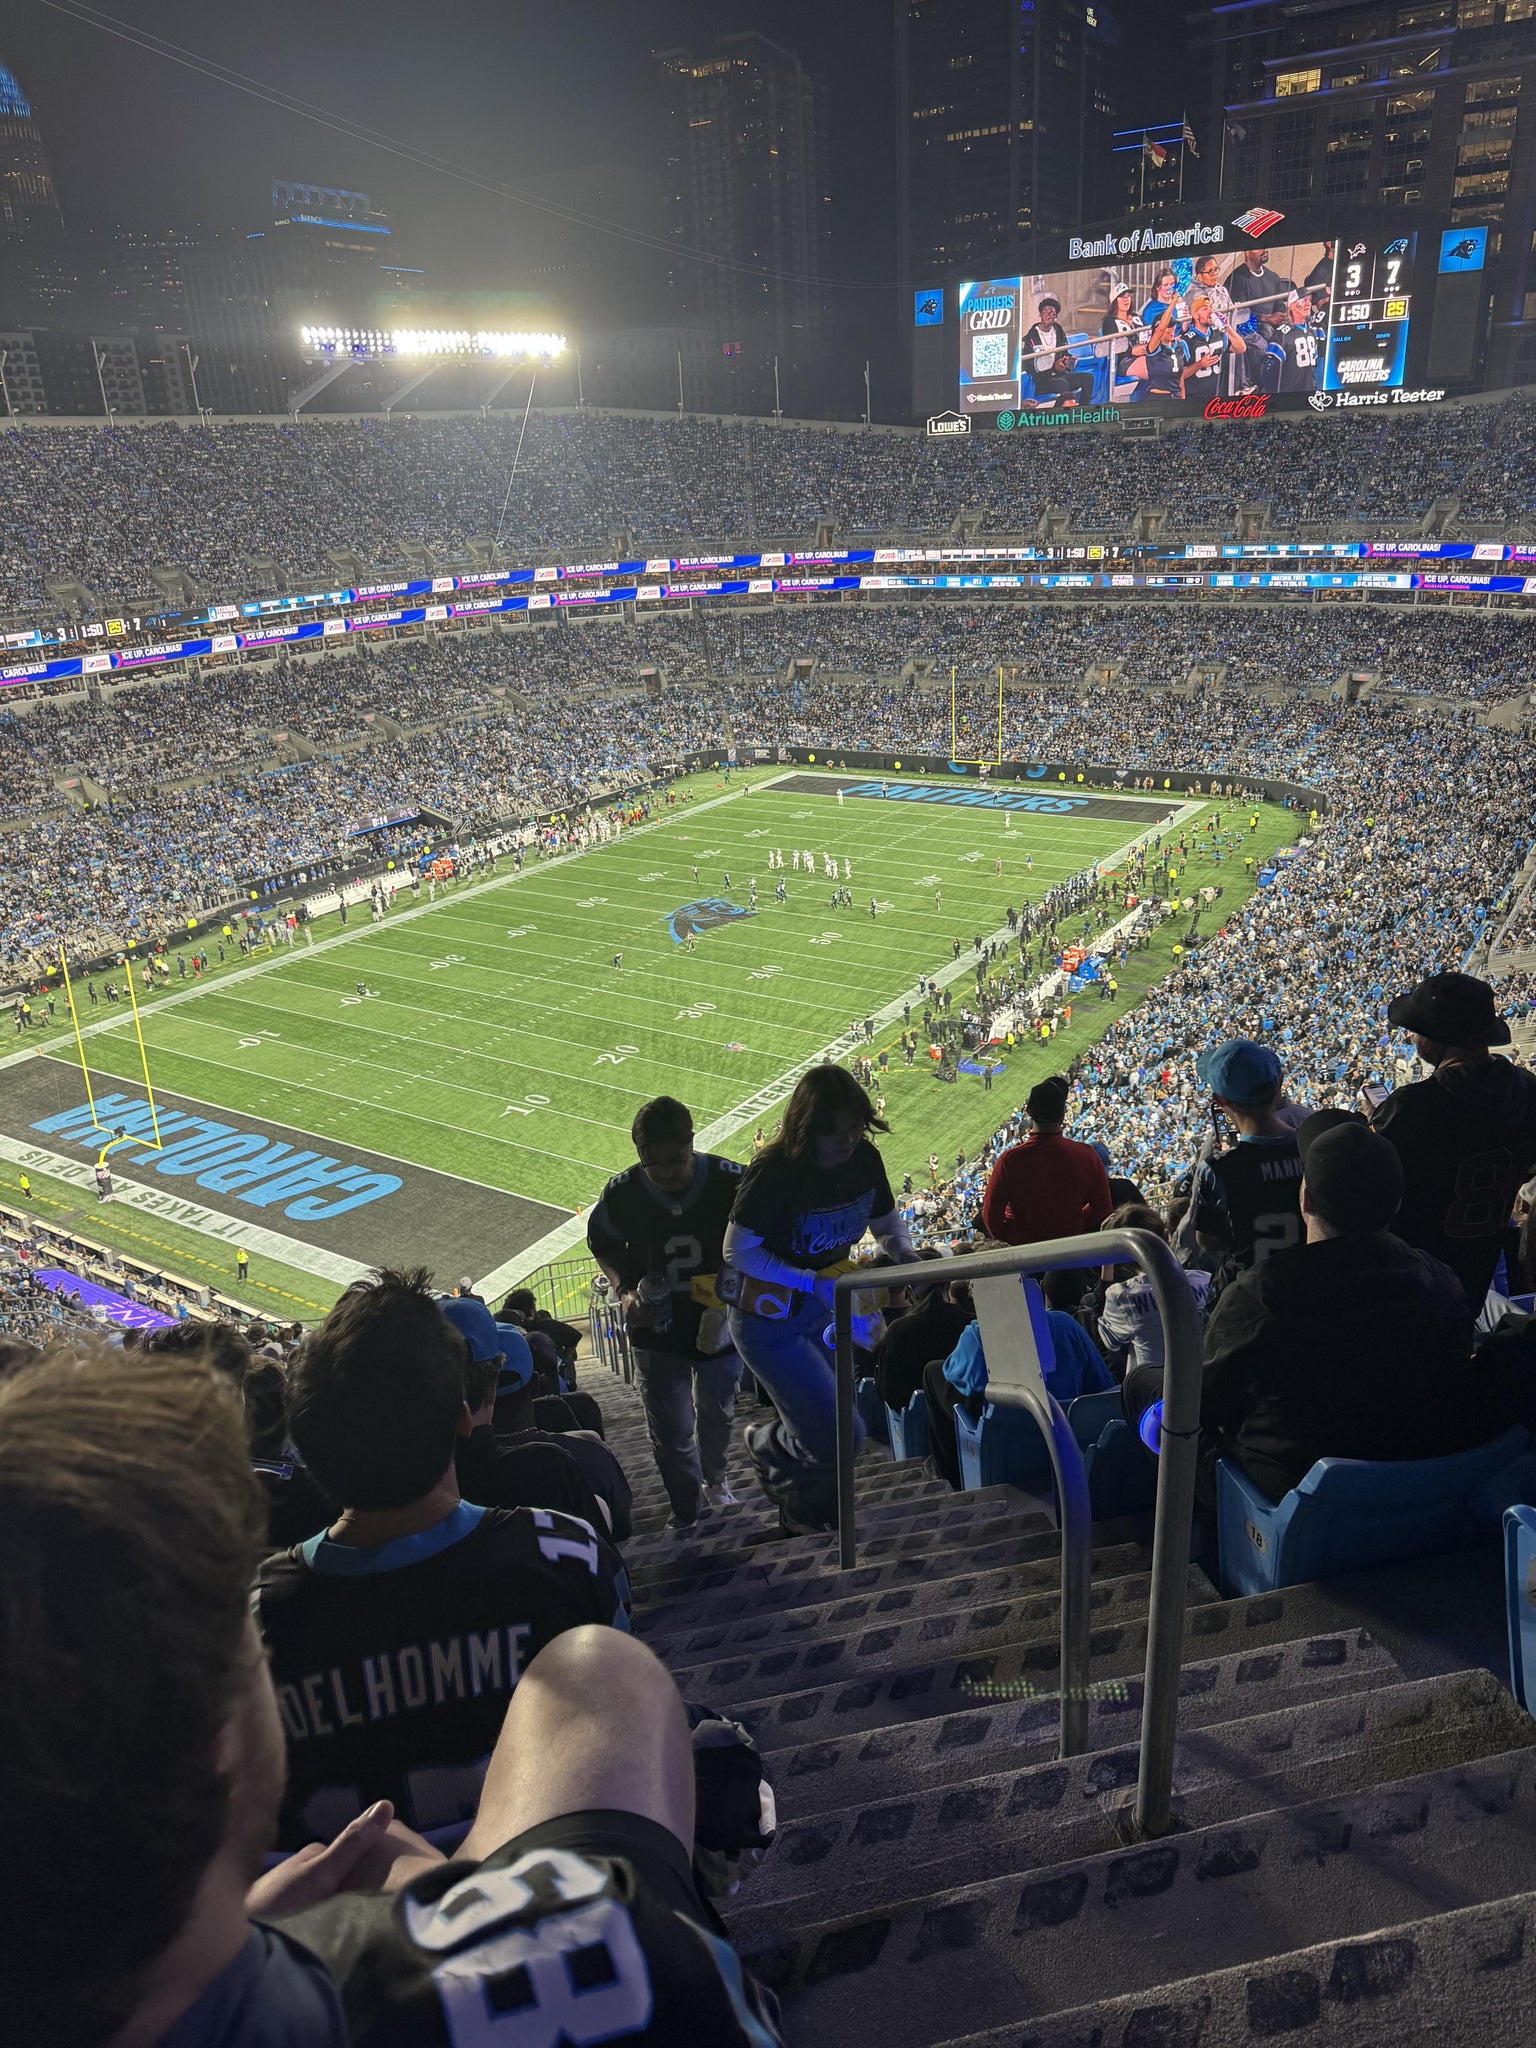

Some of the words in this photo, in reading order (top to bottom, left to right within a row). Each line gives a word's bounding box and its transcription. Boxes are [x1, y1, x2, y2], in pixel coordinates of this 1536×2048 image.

[1069, 234, 1117, 259] Bank
[1118, 230, 1141, 253] of
[1141, 222, 1224, 251] America
[1346, 265, 1361, 288] 3
[1387, 261, 1400, 285] 7
[967, 294, 1014, 312] PANTHERS
[1386, 301, 1405, 317] 25
[970, 309, 1011, 331] GRID
[1339, 304, 1370, 321] 1:50
[1337, 358, 1384, 373] CAROLINA
[1341, 369, 1391, 383] PANTHERS
[1335, 391, 1388, 407] Harris
[1391, 388, 1445, 403] Teeter
[1017, 411, 1070, 427] Atrium
[1072, 407, 1120, 426] Health
[931, 418, 967, 433] LOWE'S
[1047, 548, 1053, 558] 3
[1067, 548, 1085, 558] 1:50
[1113, 547, 1119, 558] 7
[1516, 546, 1527, 554] ICE
[566, 565, 575, 573] ICE
[462, 575, 471, 583] ICE
[1450, 576, 1490, 584] CAROLINAS!
[359, 586, 368, 595] ICE
[81, 624, 103, 638] 1:50
[108, 622, 122, 634] 25
[133, 618, 140, 631] 7
[57, 628, 65, 641] 3
[246, 633, 255, 641] ICE
[122, 651, 133, 660] ICE
[146, 644, 182, 656] CAROLINAS!
[3, 664, 47, 678] CAROLINAS!
[840, 782, 1089, 812] PANTHERS
[809, 931, 843, 945] 50
[751, 964, 784, 981] 40
[680, 1001, 717, 1019] 30
[599, 1044, 639, 1066] 20
[504, 1094, 550, 1117] 10
[29, 1093, 403, 1221] CAROLINA
[1444, 1142, 1532, 1238] 8
[131, 1191, 212, 1226] TAKES
[664, 1235, 702, 1292] 2
[1250, 1525, 1263, 1548] 18
[278, 1622, 532, 1743] DELHOMME
